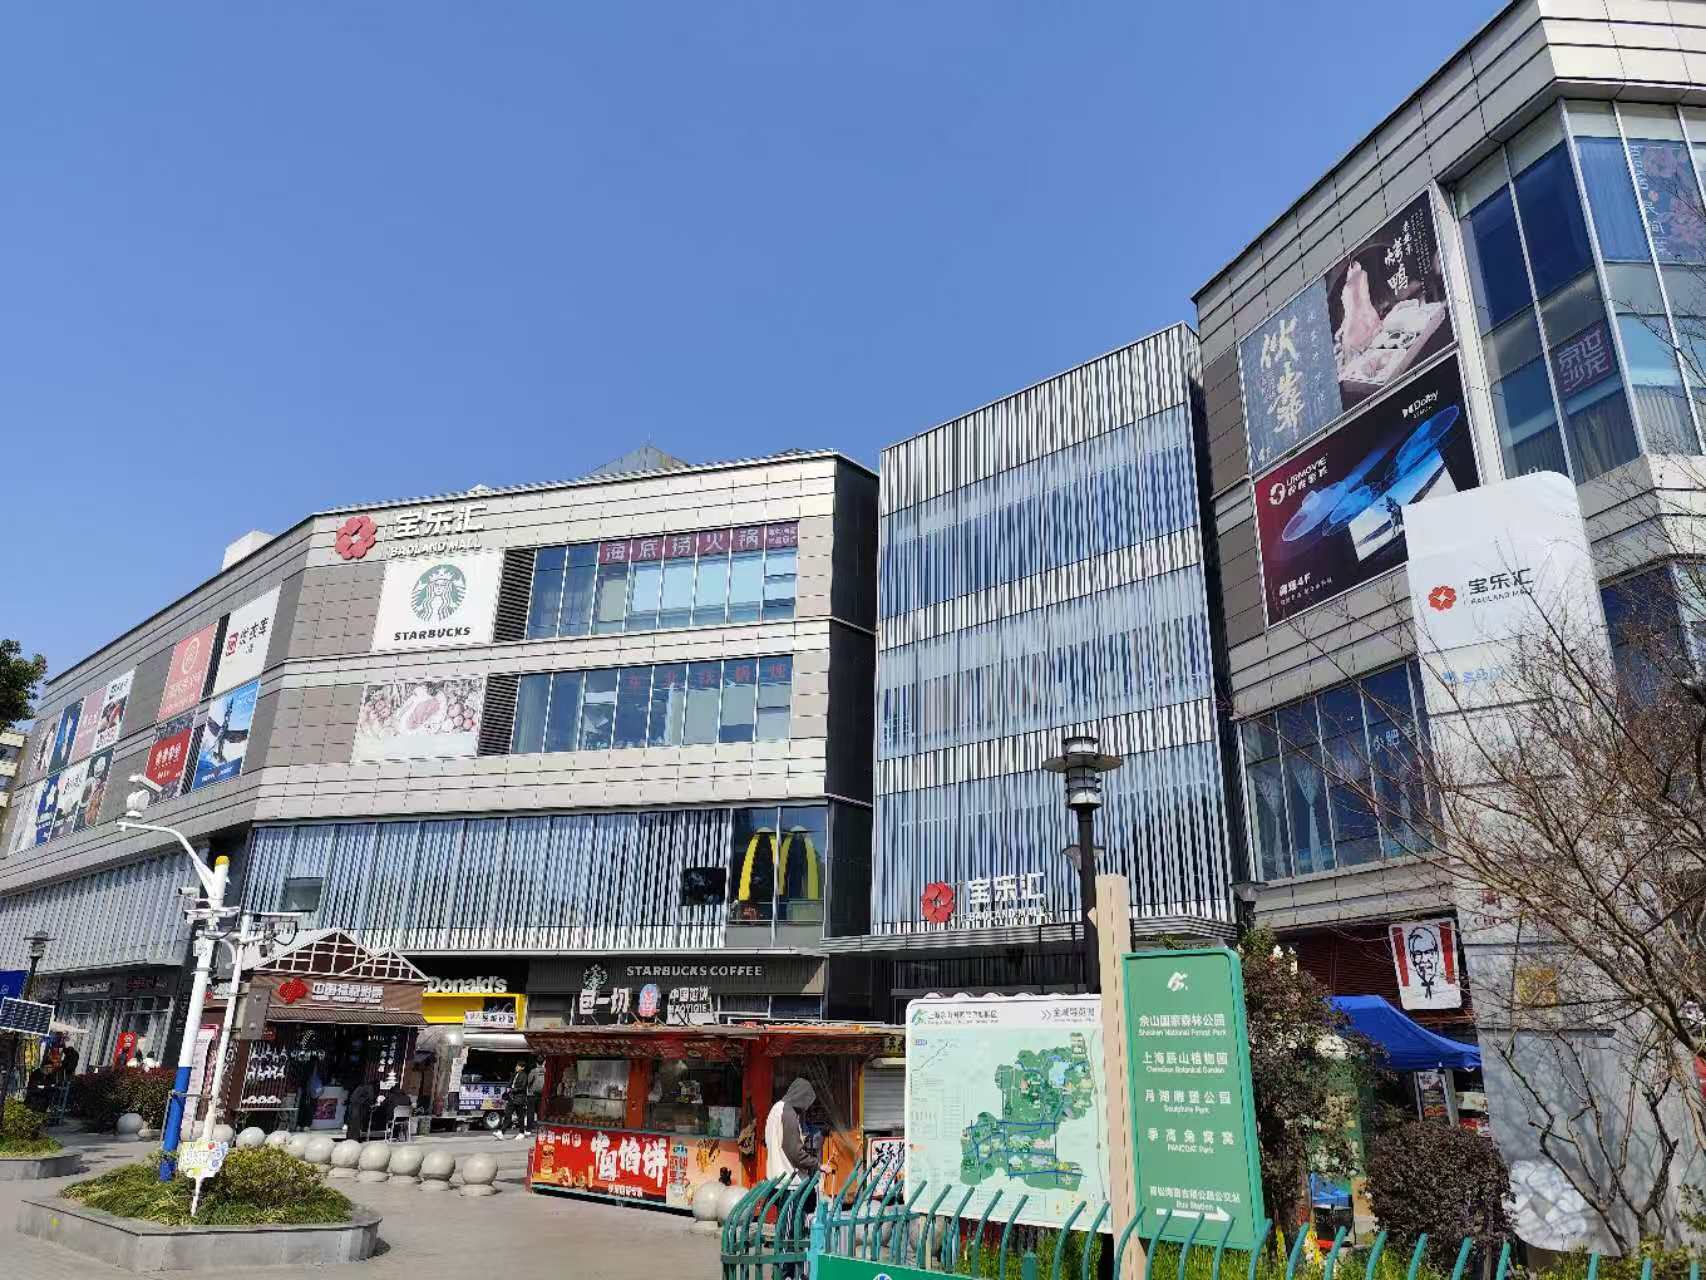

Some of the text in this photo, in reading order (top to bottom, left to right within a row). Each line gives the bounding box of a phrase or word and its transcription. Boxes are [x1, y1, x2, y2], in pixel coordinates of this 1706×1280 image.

[1413, 392, 1439, 411] Dolby
[1286, 455, 1327, 486] URMOVIE
[393, 501, 488, 540] 宝乐汇
[390, 537, 482, 558] BAOLAND MALL
[1468, 568, 1533, 595] 宝乐汇
[394, 627, 471, 641] STARBUCKS
[968, 872, 1044, 904] 宝乐汇
[627, 965, 763, 976] STARBUCKS COFFEE
[425, 976, 508, 993] Donald's
[579, 987, 630, 1015] 包一切
[1139, 1013, 1225, 1027] 佘山国家森林公园
[1165, 1028, 1190, 1036] National
[1191, 1028, 1211, 1036] Forest
[1212, 1028, 1227, 1036] Park
[1142, 1051, 1228, 1065] 上海辰山植物园
[1202, 1066, 1225, 1074] Garden
[1144, 1088, 1232, 1104] 月湖雕塑公园
[1194, 1105, 1209, 1114] Park
[1147, 1127, 1234, 1145] 季高兔窝窝
[1198, 1145, 1214, 1154] Park
[1175, 1200, 1214, 1211] Bus Station
